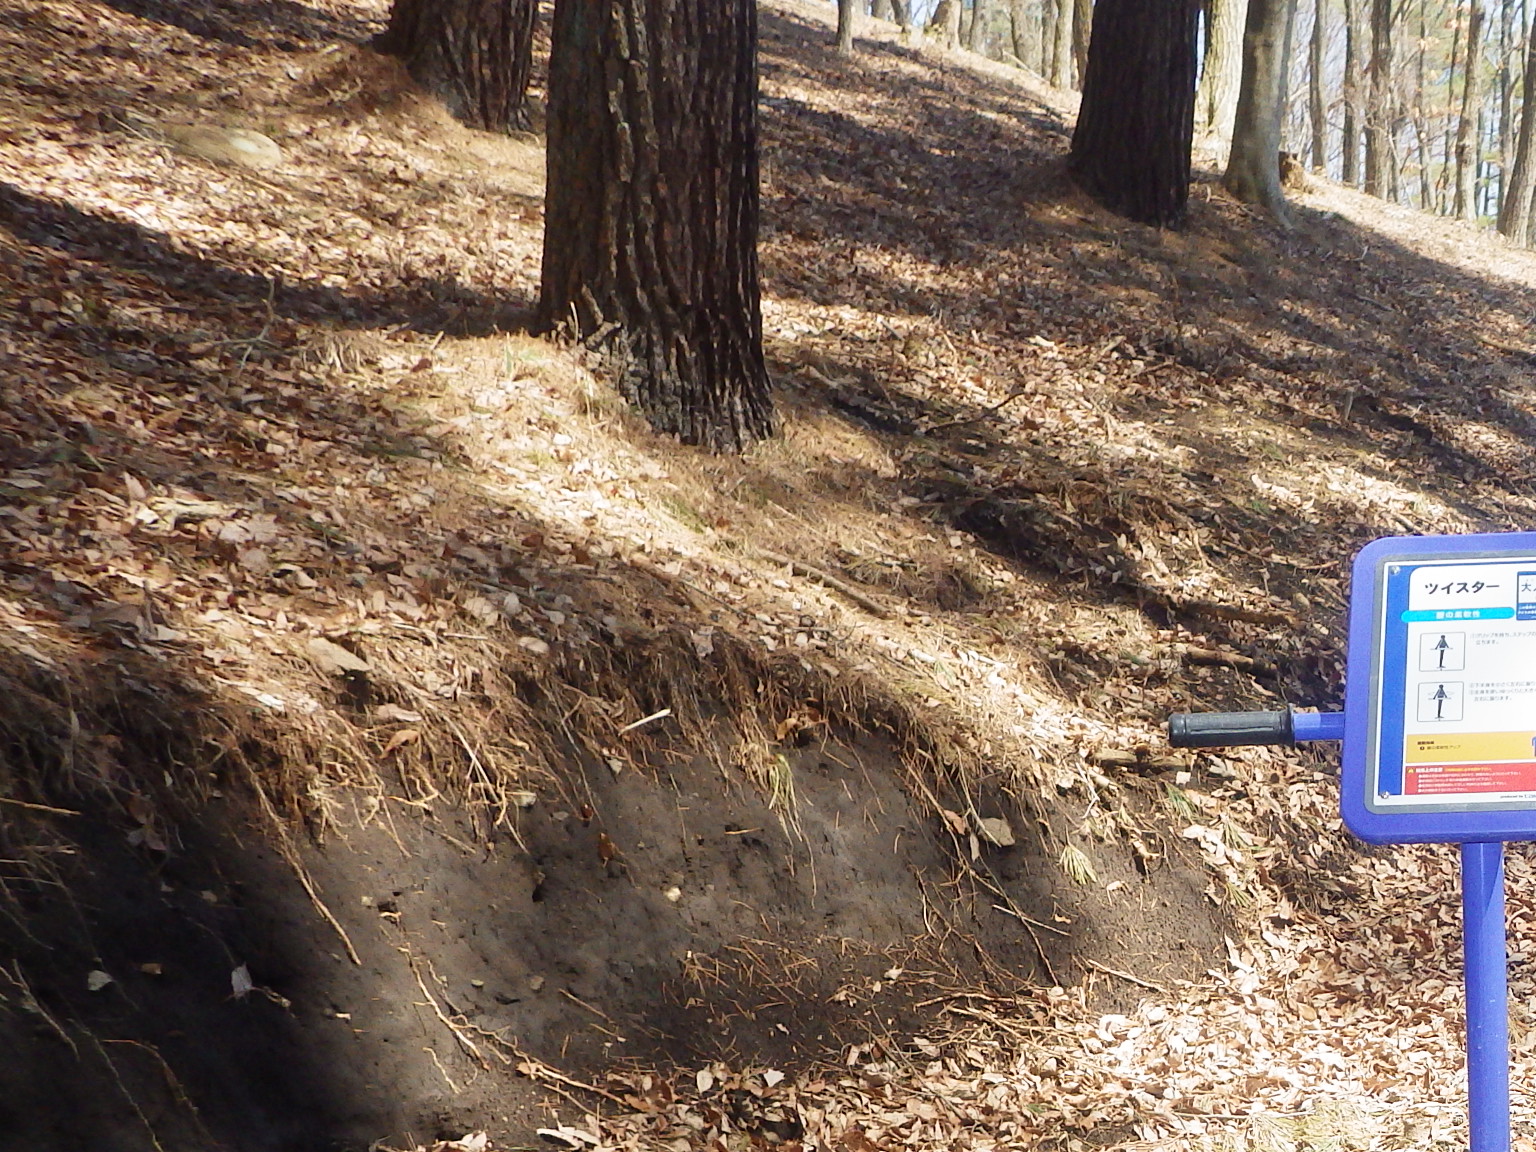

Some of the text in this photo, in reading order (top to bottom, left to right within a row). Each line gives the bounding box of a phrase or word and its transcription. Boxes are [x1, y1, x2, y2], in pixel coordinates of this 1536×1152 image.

[1425, 581, 1500, 595] ツイスター
